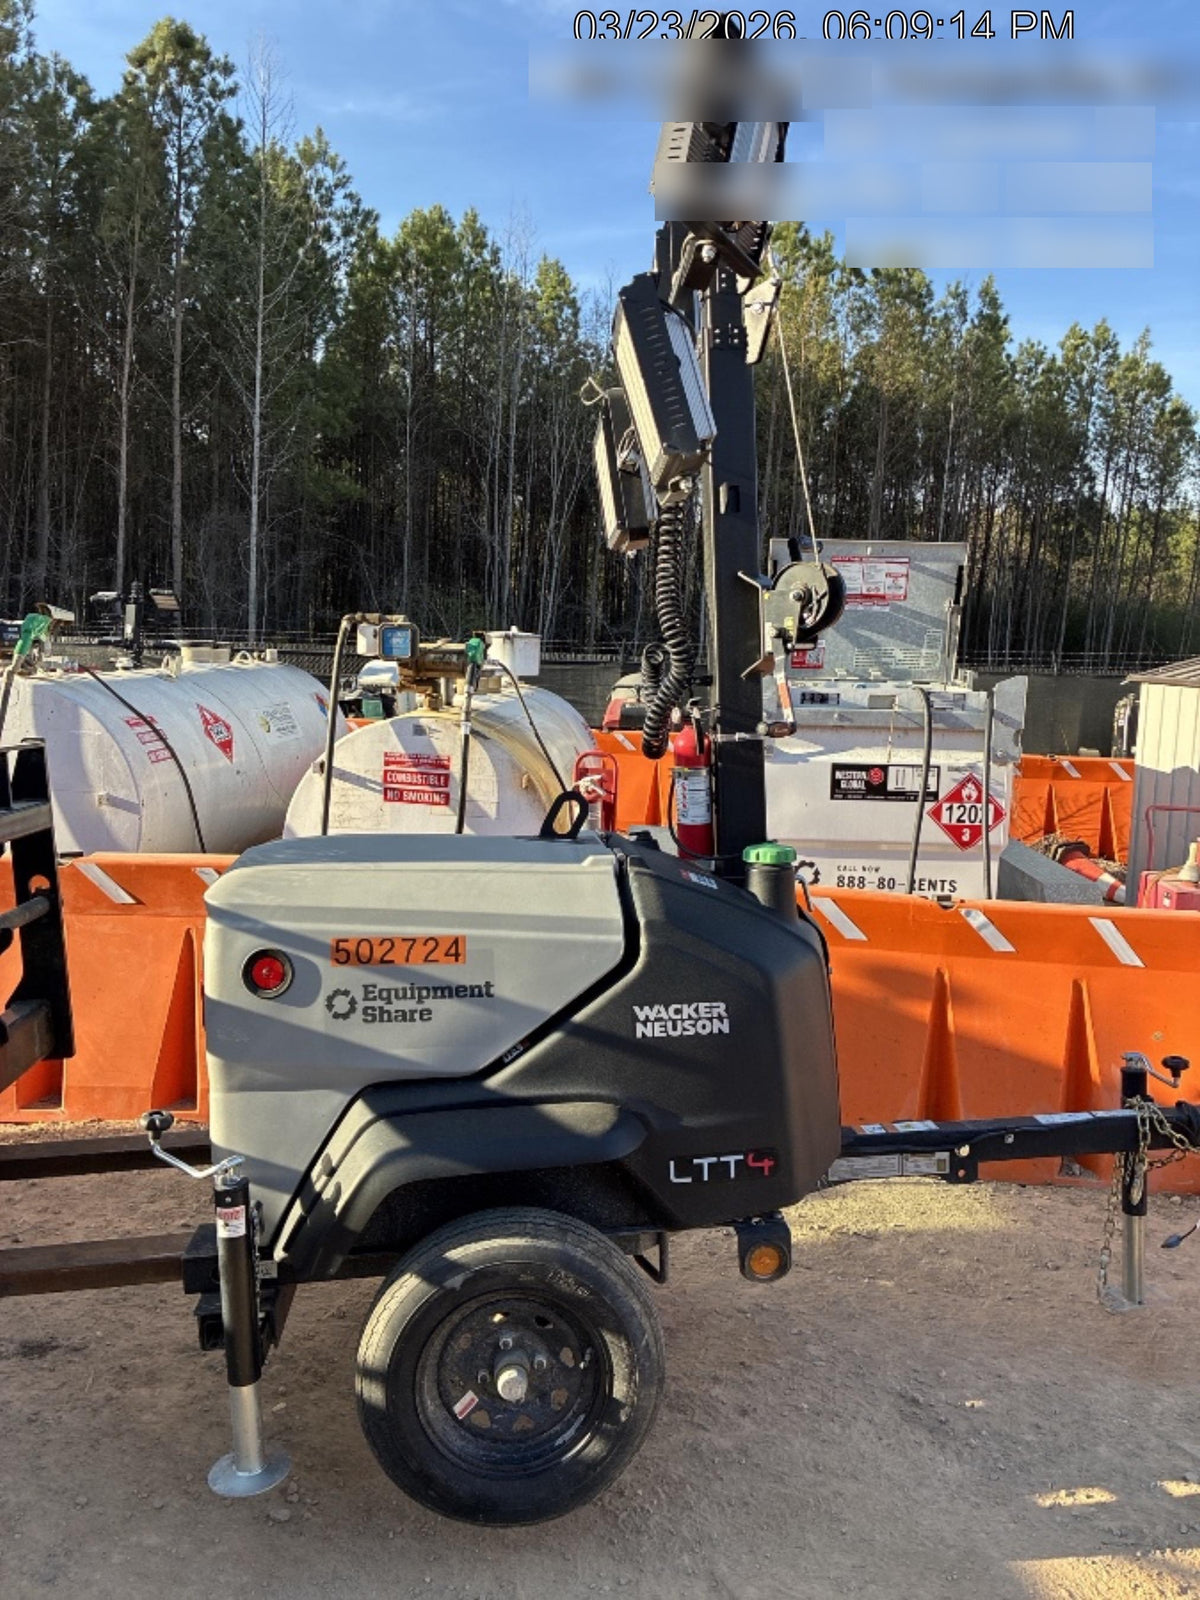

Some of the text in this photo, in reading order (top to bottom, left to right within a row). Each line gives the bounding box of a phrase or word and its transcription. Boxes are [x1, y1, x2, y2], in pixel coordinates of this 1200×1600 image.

[387, 771, 445, 786] COMBUSTIBLE
[387, 789, 446, 804] NO SMOKING
[961, 828, 970, 842] 3
[862, 865, 881, 873] NOW
[334, 936, 462, 965] 502724
[362, 980, 494, 1005] Equipment
[362, 1006, 433, 1024] Share
[633, 1002, 727, 1021] WACKER
[635, 1018, 729, 1038] NEUSON
[669, 1151, 775, 1184] LTT4
